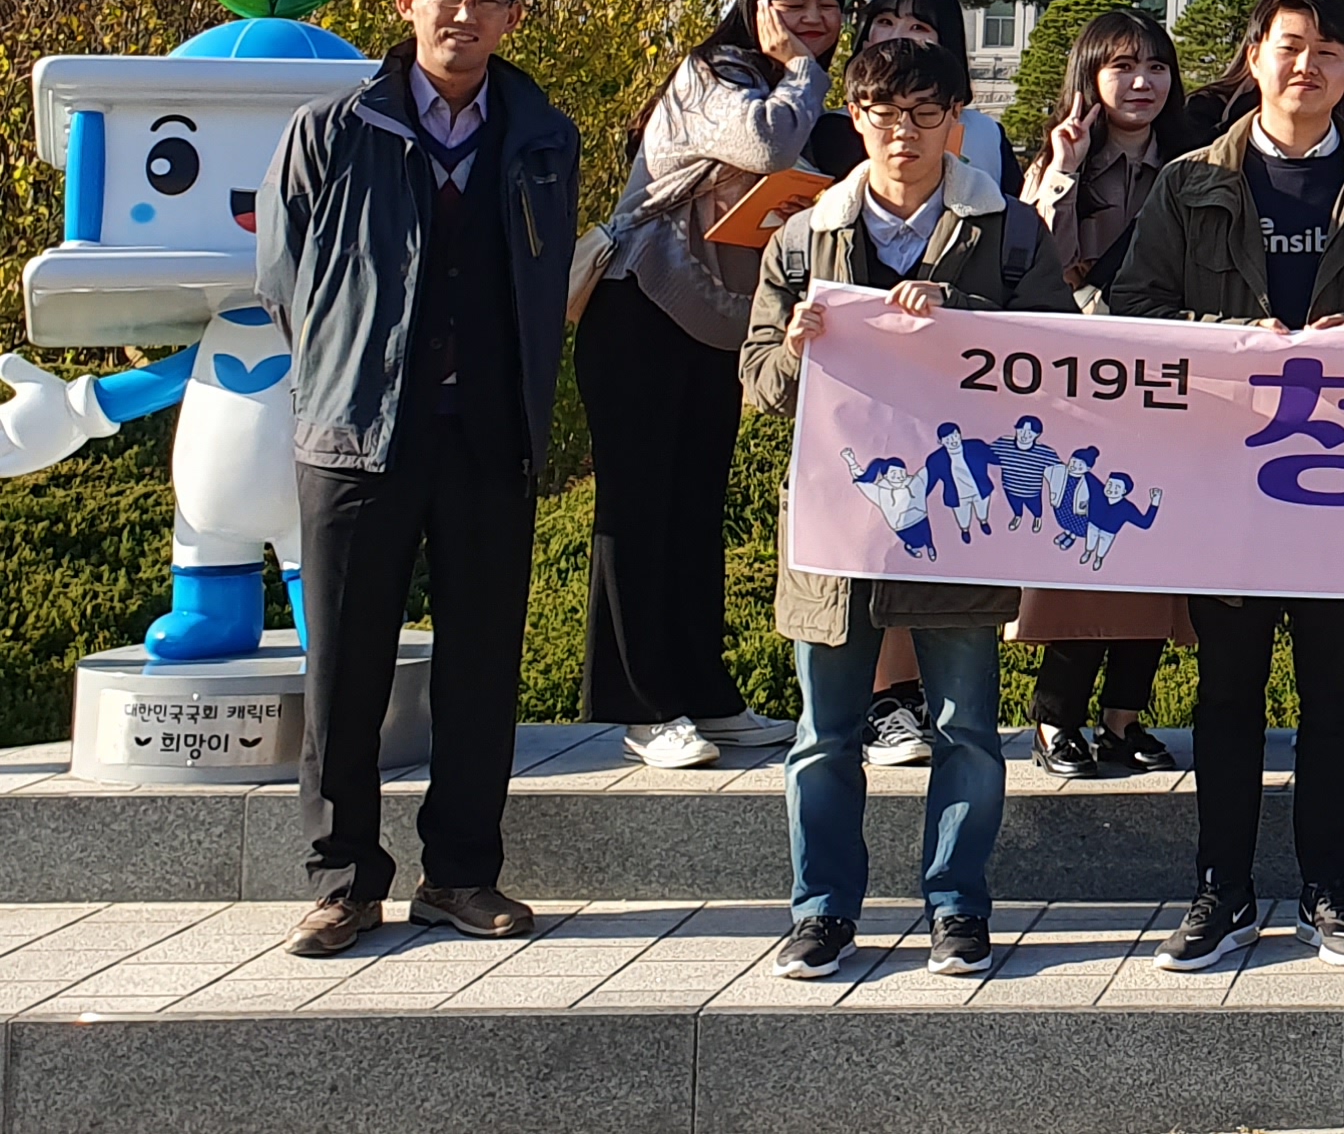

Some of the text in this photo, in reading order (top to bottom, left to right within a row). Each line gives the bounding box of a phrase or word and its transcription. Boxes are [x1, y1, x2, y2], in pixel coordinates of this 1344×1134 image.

[959, 348, 1190, 411] 2019년
[124, 703, 283, 724] 대한민국국회 캐릭터
[159, 732, 230, 760] 희망이
